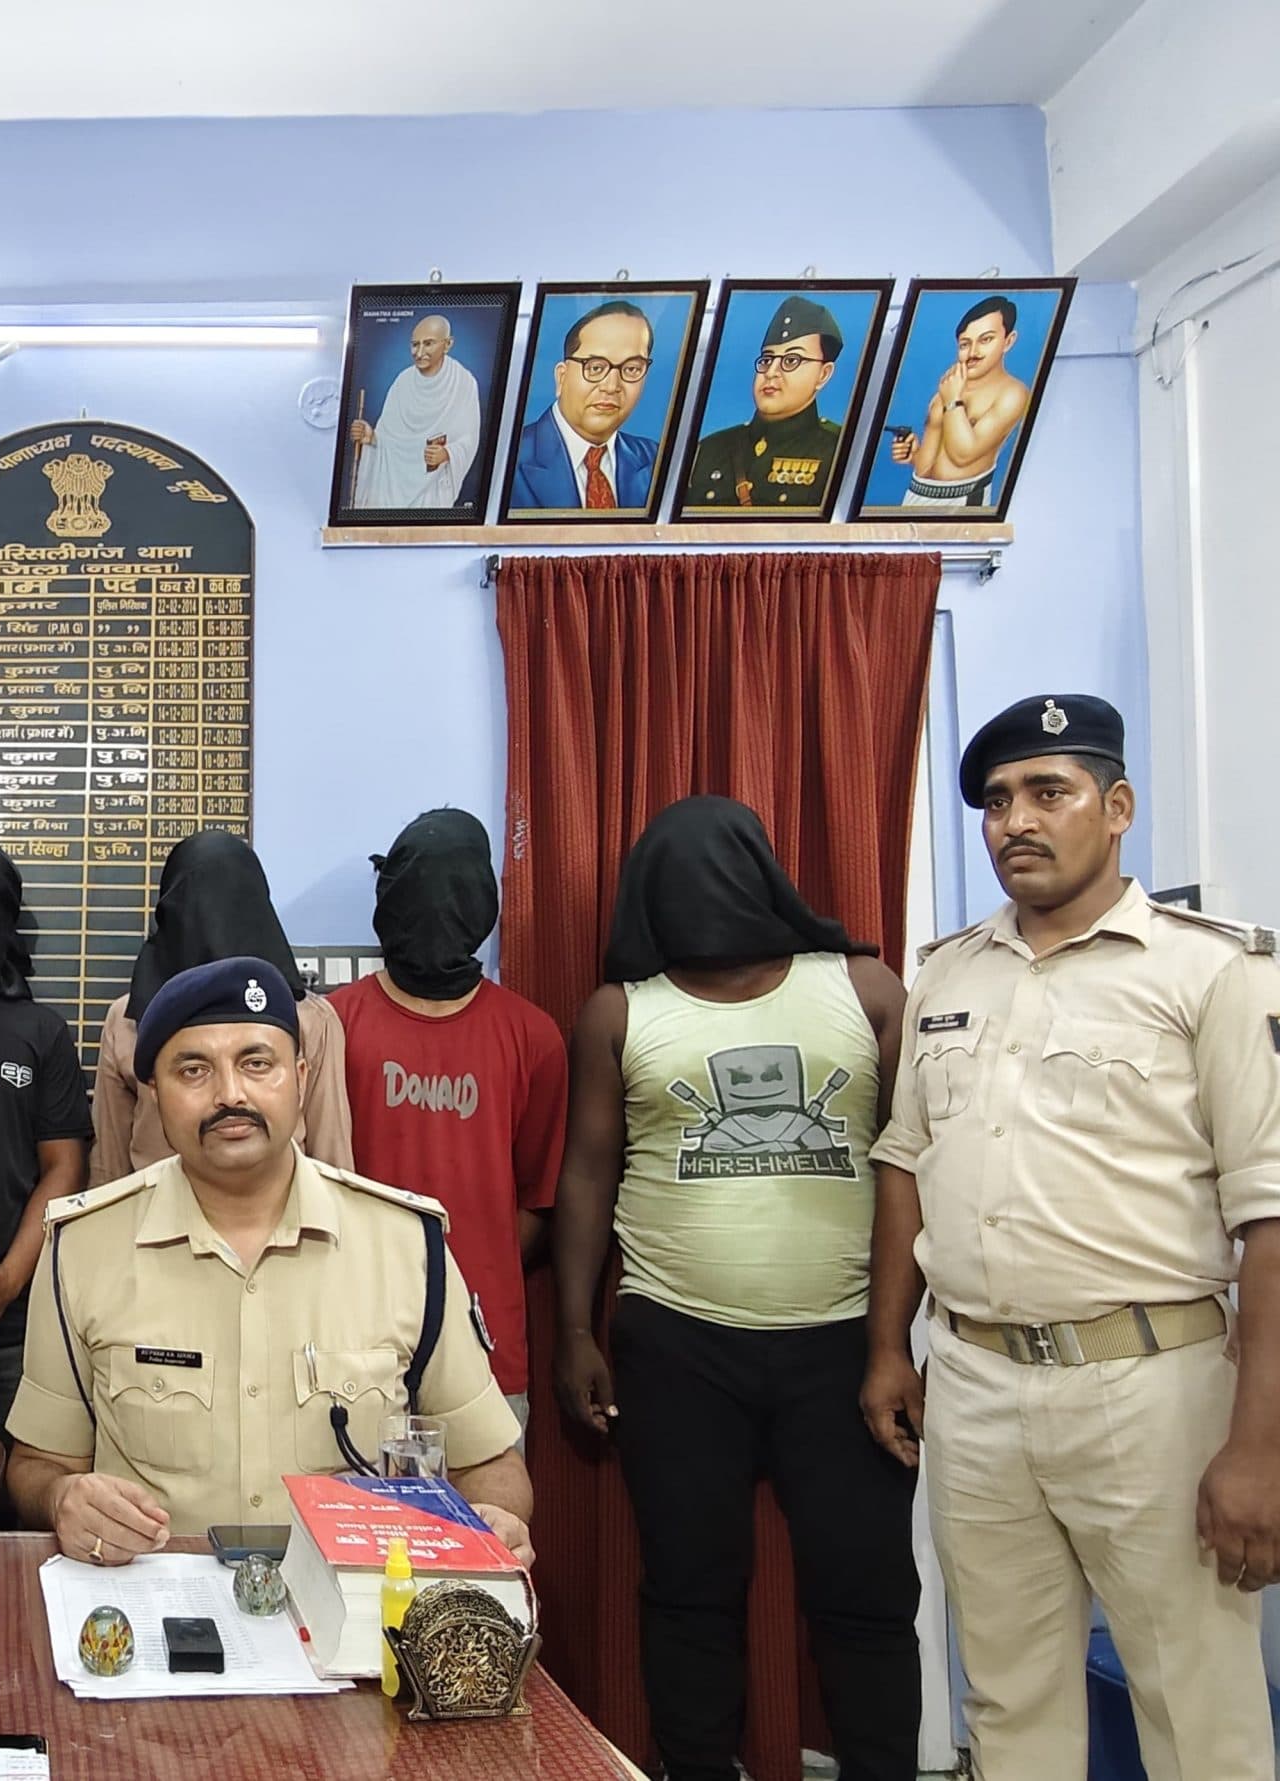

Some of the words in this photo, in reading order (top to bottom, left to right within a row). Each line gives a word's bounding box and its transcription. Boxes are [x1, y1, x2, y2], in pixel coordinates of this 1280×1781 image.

[137, 545, 193, 559] थाना
[102, 578, 138, 593] पद
[6, 621, 40, 634] सिंह
[4, 665, 61, 679] कुमार
[7, 684, 46, 696] प्रसाद
[53, 682, 82, 695] सिंह
[2, 751, 58, 765] कुमार
[2, 799, 57, 811] कुमार
[29, 840, 69, 857] सिन्हा
